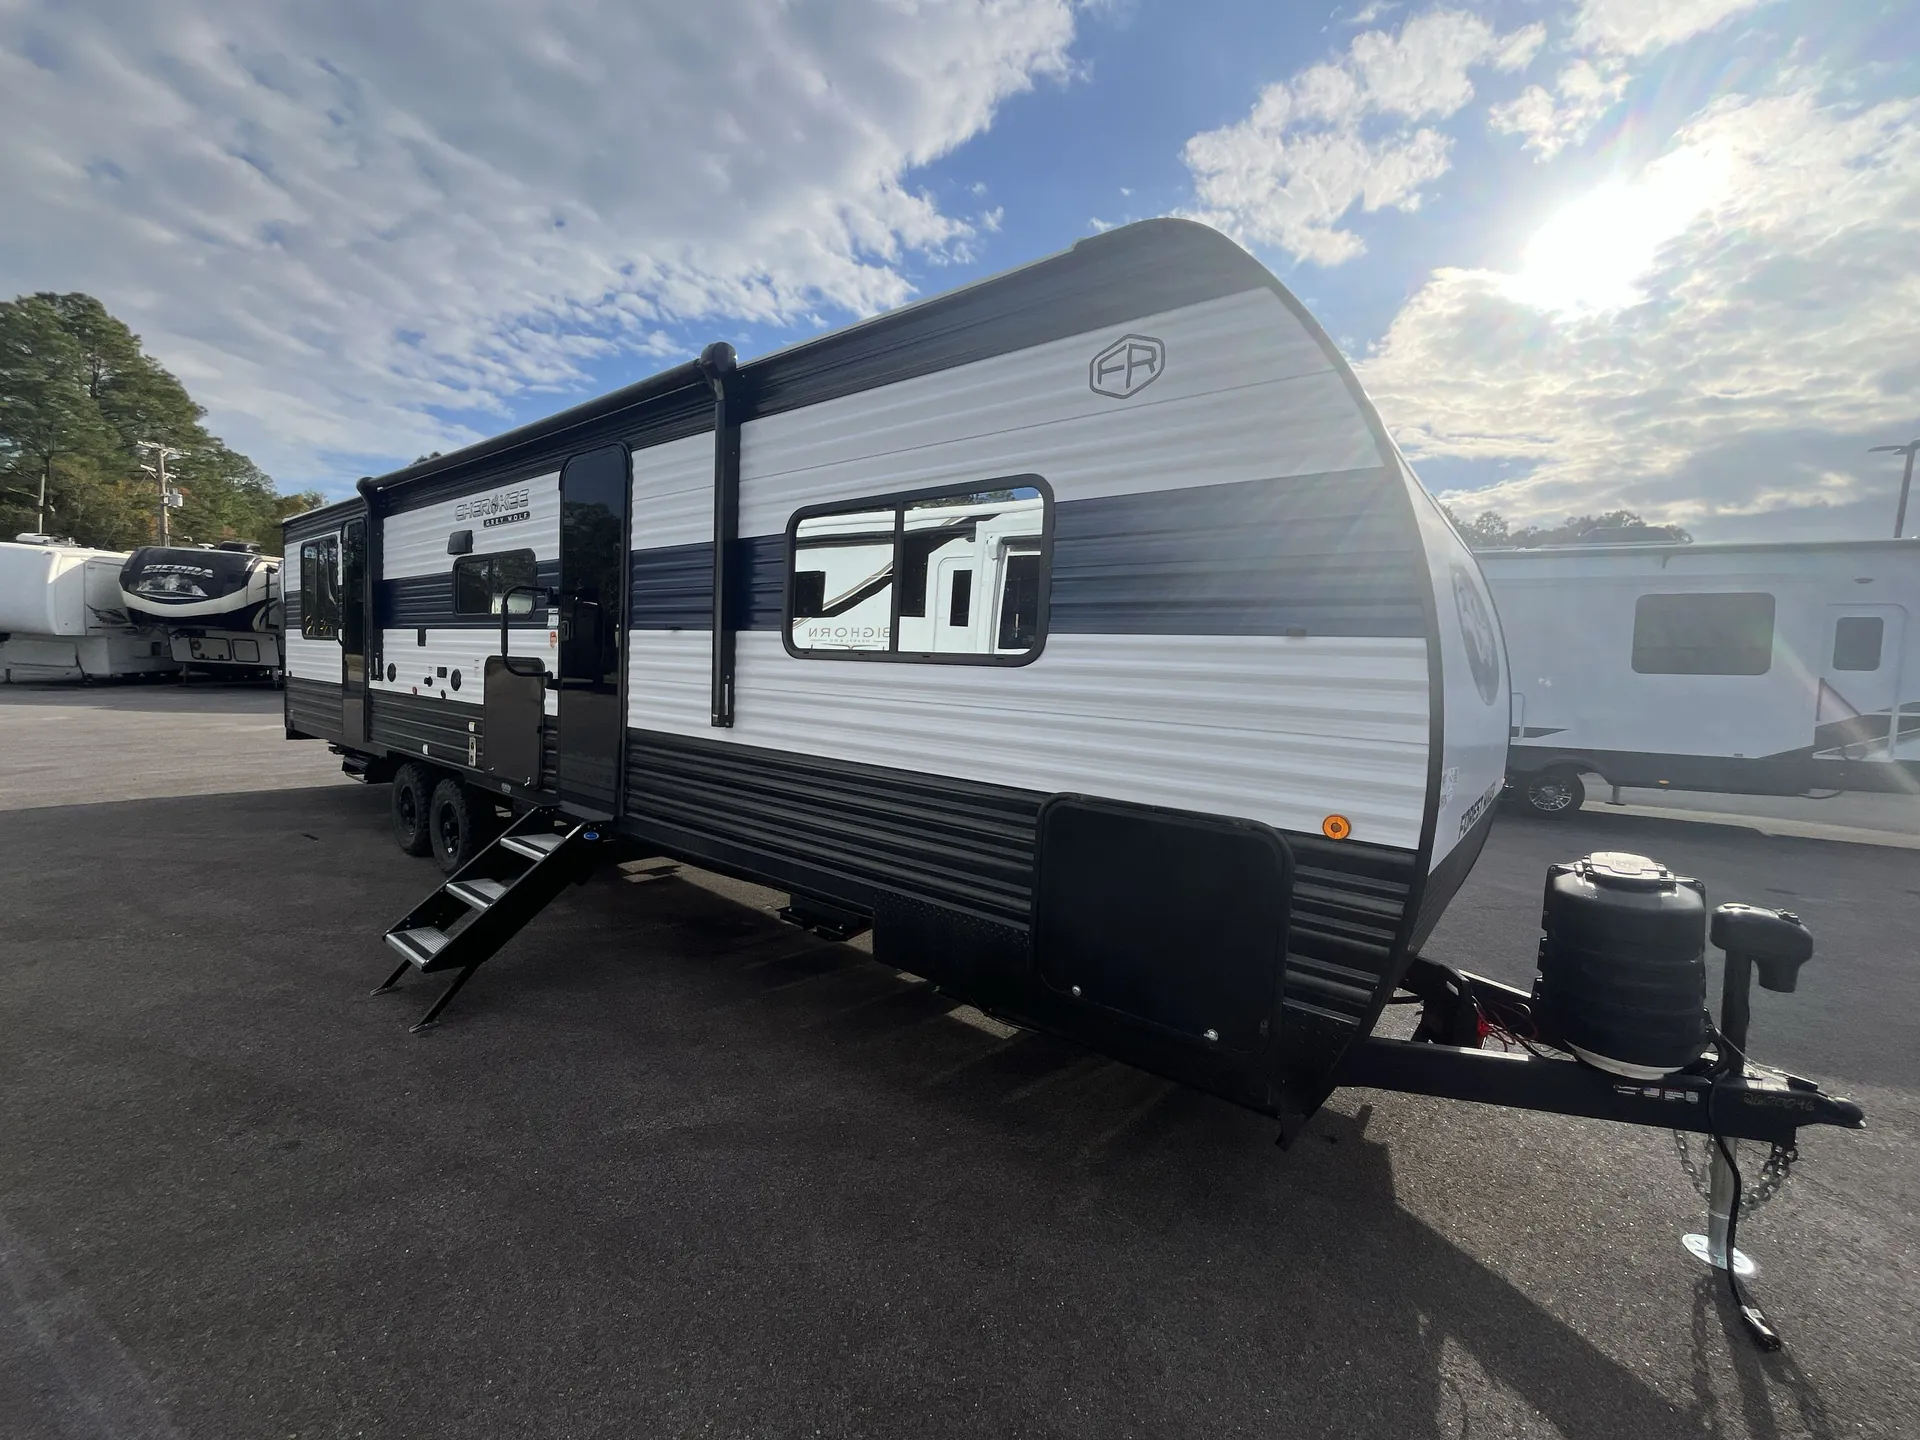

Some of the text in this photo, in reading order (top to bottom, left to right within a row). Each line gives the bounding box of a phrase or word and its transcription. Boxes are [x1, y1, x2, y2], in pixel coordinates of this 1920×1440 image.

[1097, 343, 1157, 389] FR
[456, 489, 530, 521] CHEROKEE
[485, 512, 528, 526] GREY WOLF
[141, 564, 213, 578] SIERRA
